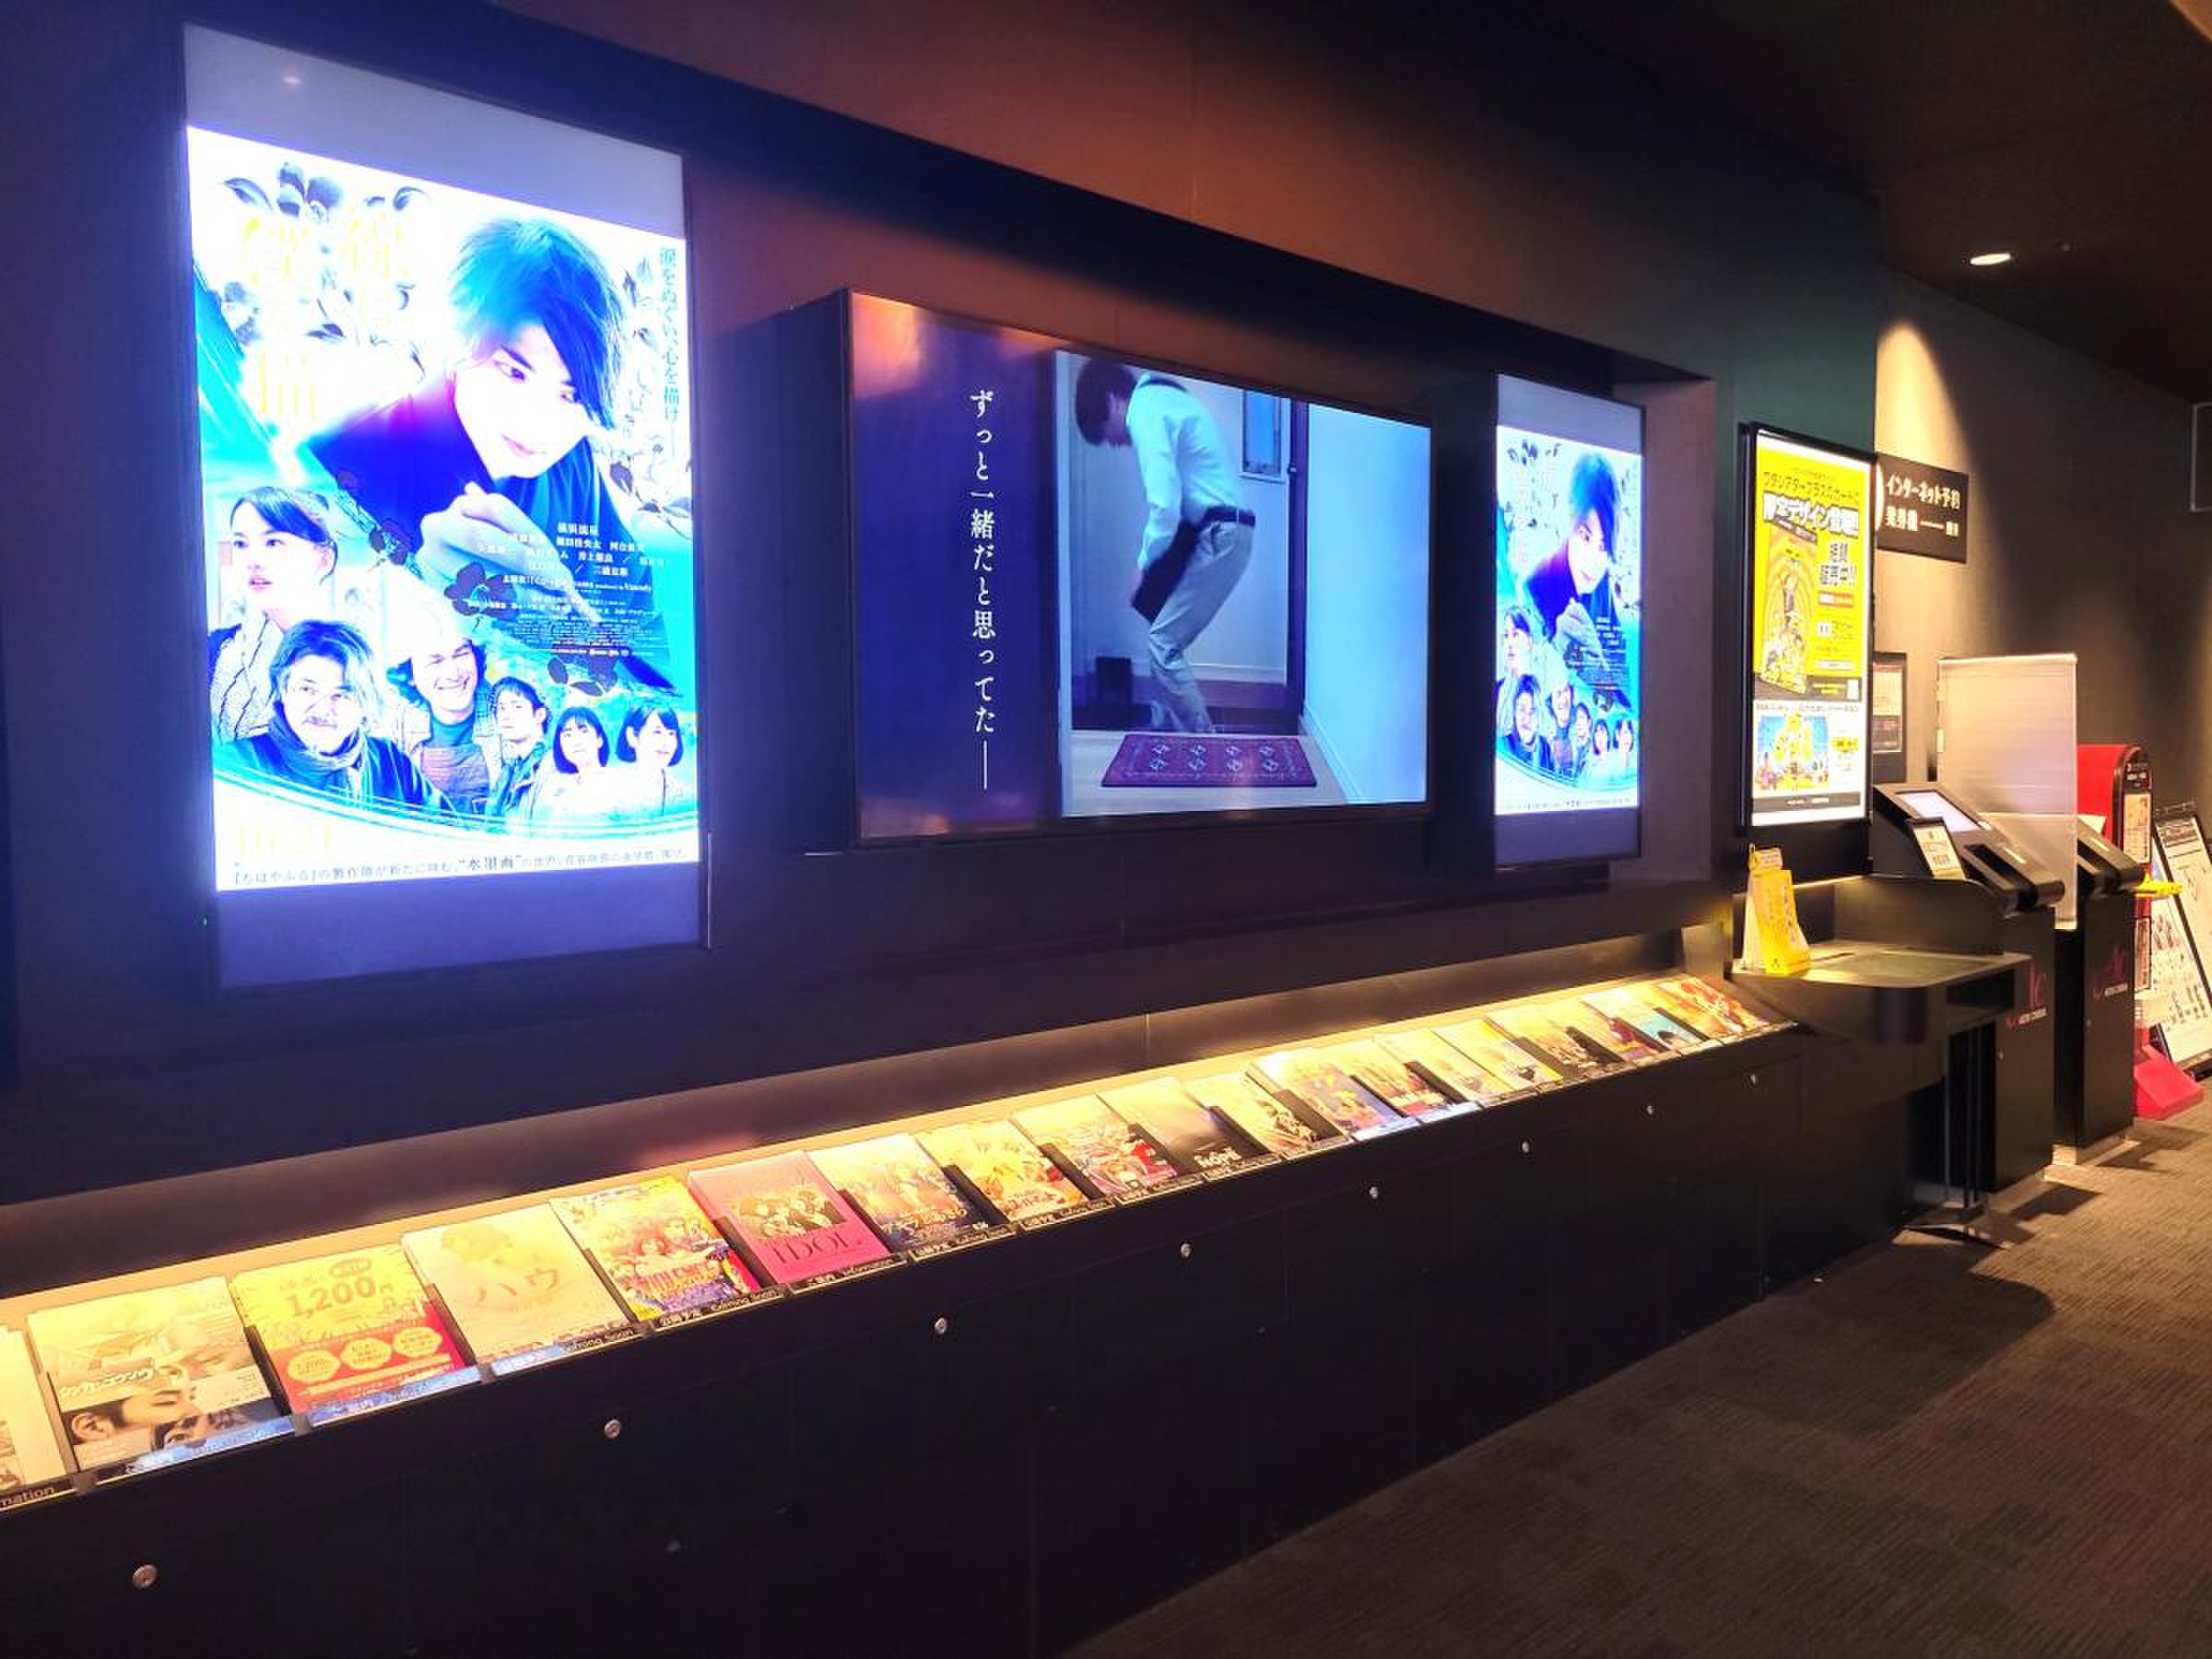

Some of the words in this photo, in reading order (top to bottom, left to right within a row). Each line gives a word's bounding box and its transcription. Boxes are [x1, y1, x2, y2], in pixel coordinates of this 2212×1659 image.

[1887, 473, 1961, 511] インターネット予約
